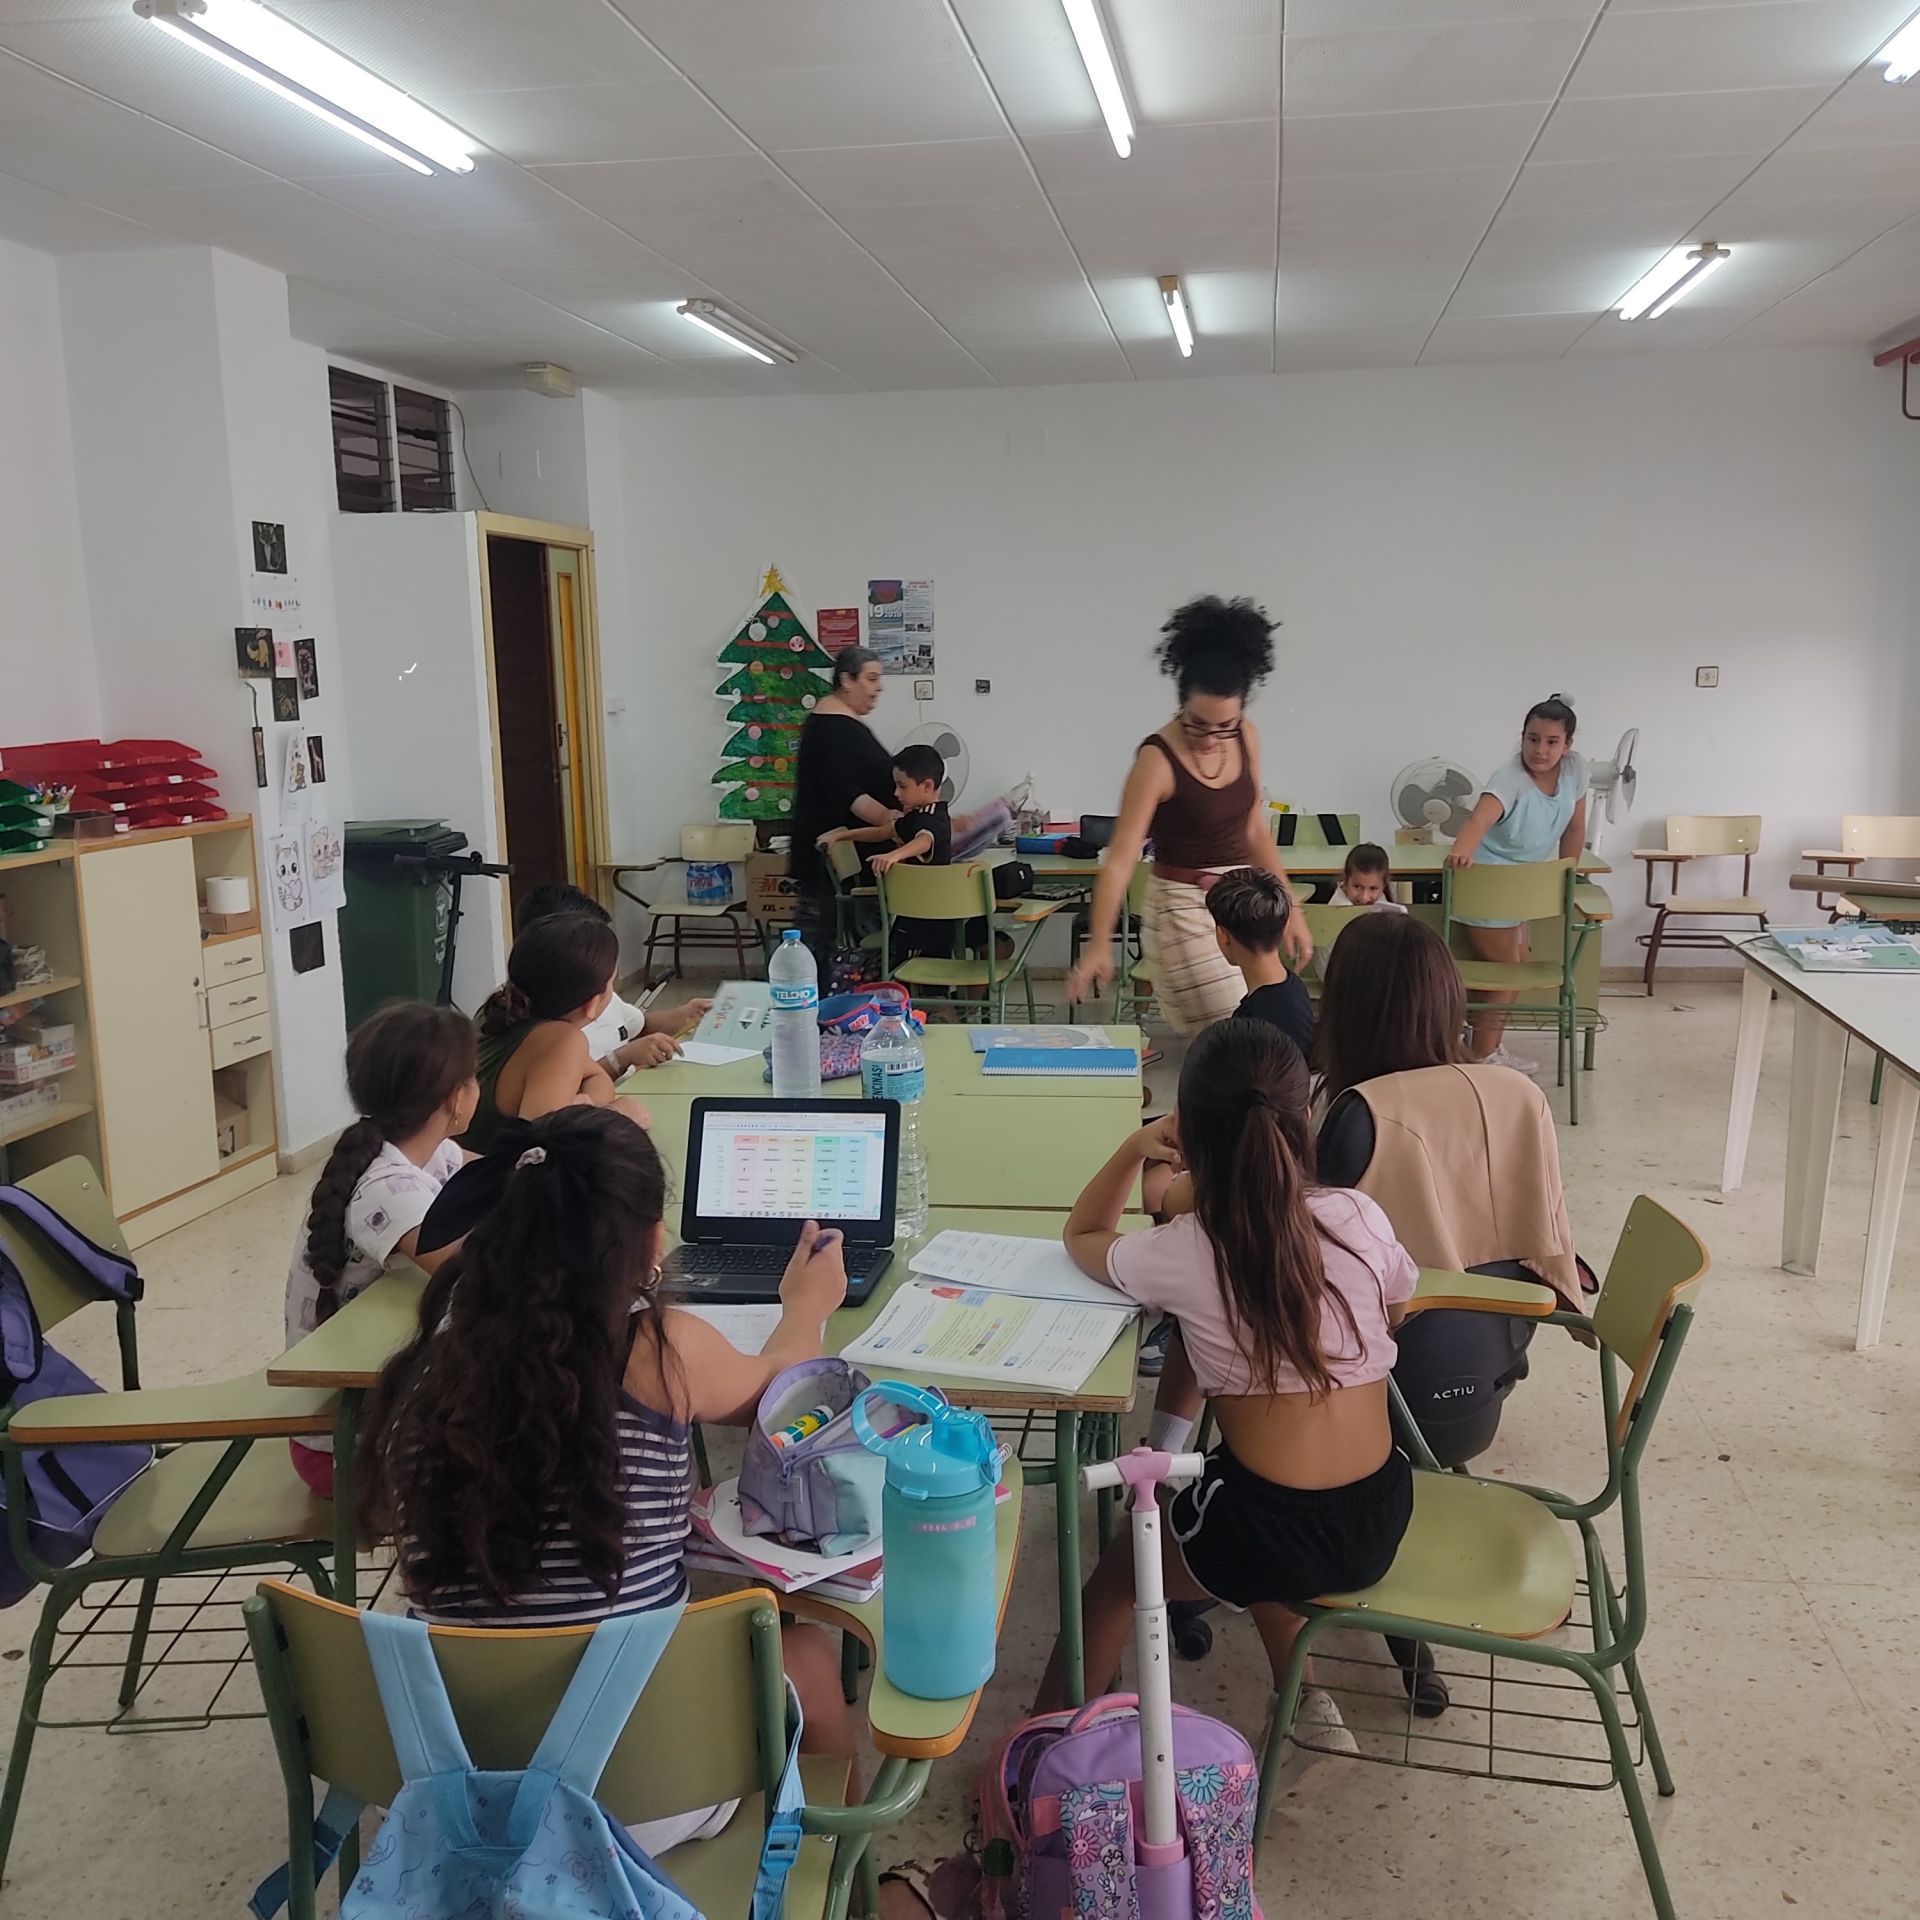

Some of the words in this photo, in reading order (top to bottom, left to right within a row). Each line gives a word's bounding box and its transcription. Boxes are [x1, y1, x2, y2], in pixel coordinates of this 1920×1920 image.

[869, 604, 883, 618] 19
[762, 904, 777, 912] XXL
[775, 990, 811, 1000] TELENO
[1433, 1385, 1475, 1400] ACTIU
